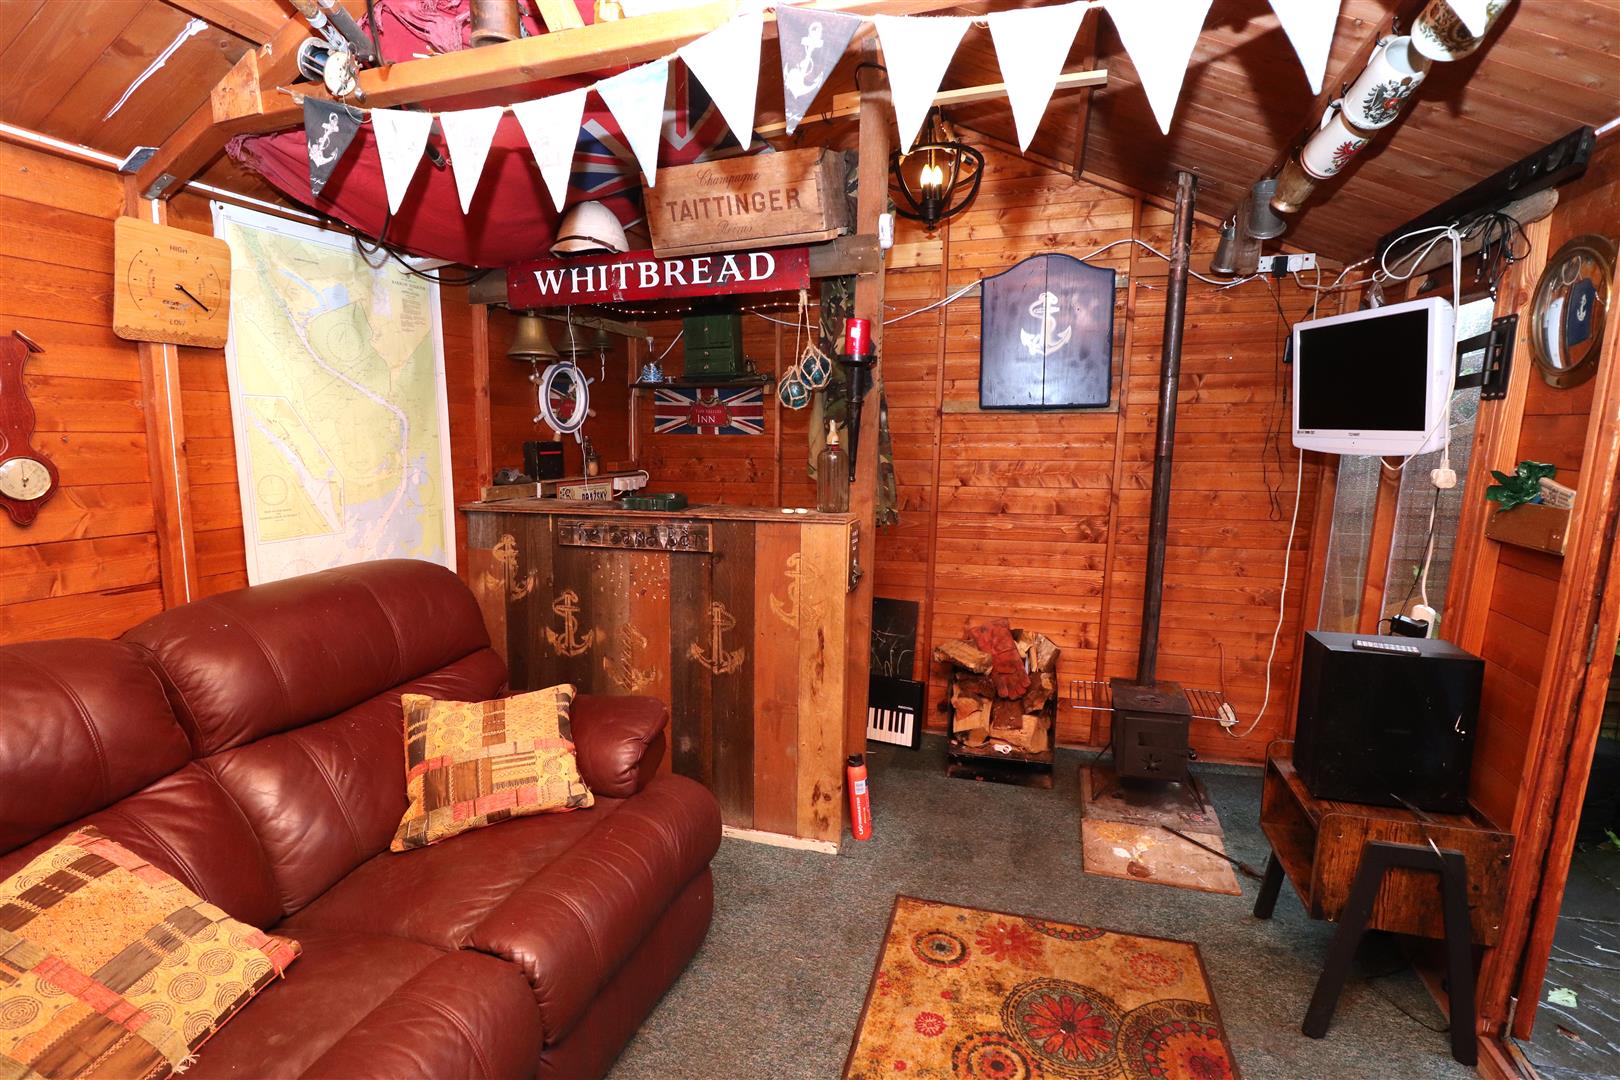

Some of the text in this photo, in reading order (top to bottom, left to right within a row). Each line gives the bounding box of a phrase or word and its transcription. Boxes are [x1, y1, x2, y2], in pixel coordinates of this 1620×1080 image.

[697, 169, 760, 190] Champagne
[665, 187, 801, 222] TAITTINGER
[533, 252, 776, 296] WHITBREAD
[697, 414, 717, 424] INN
